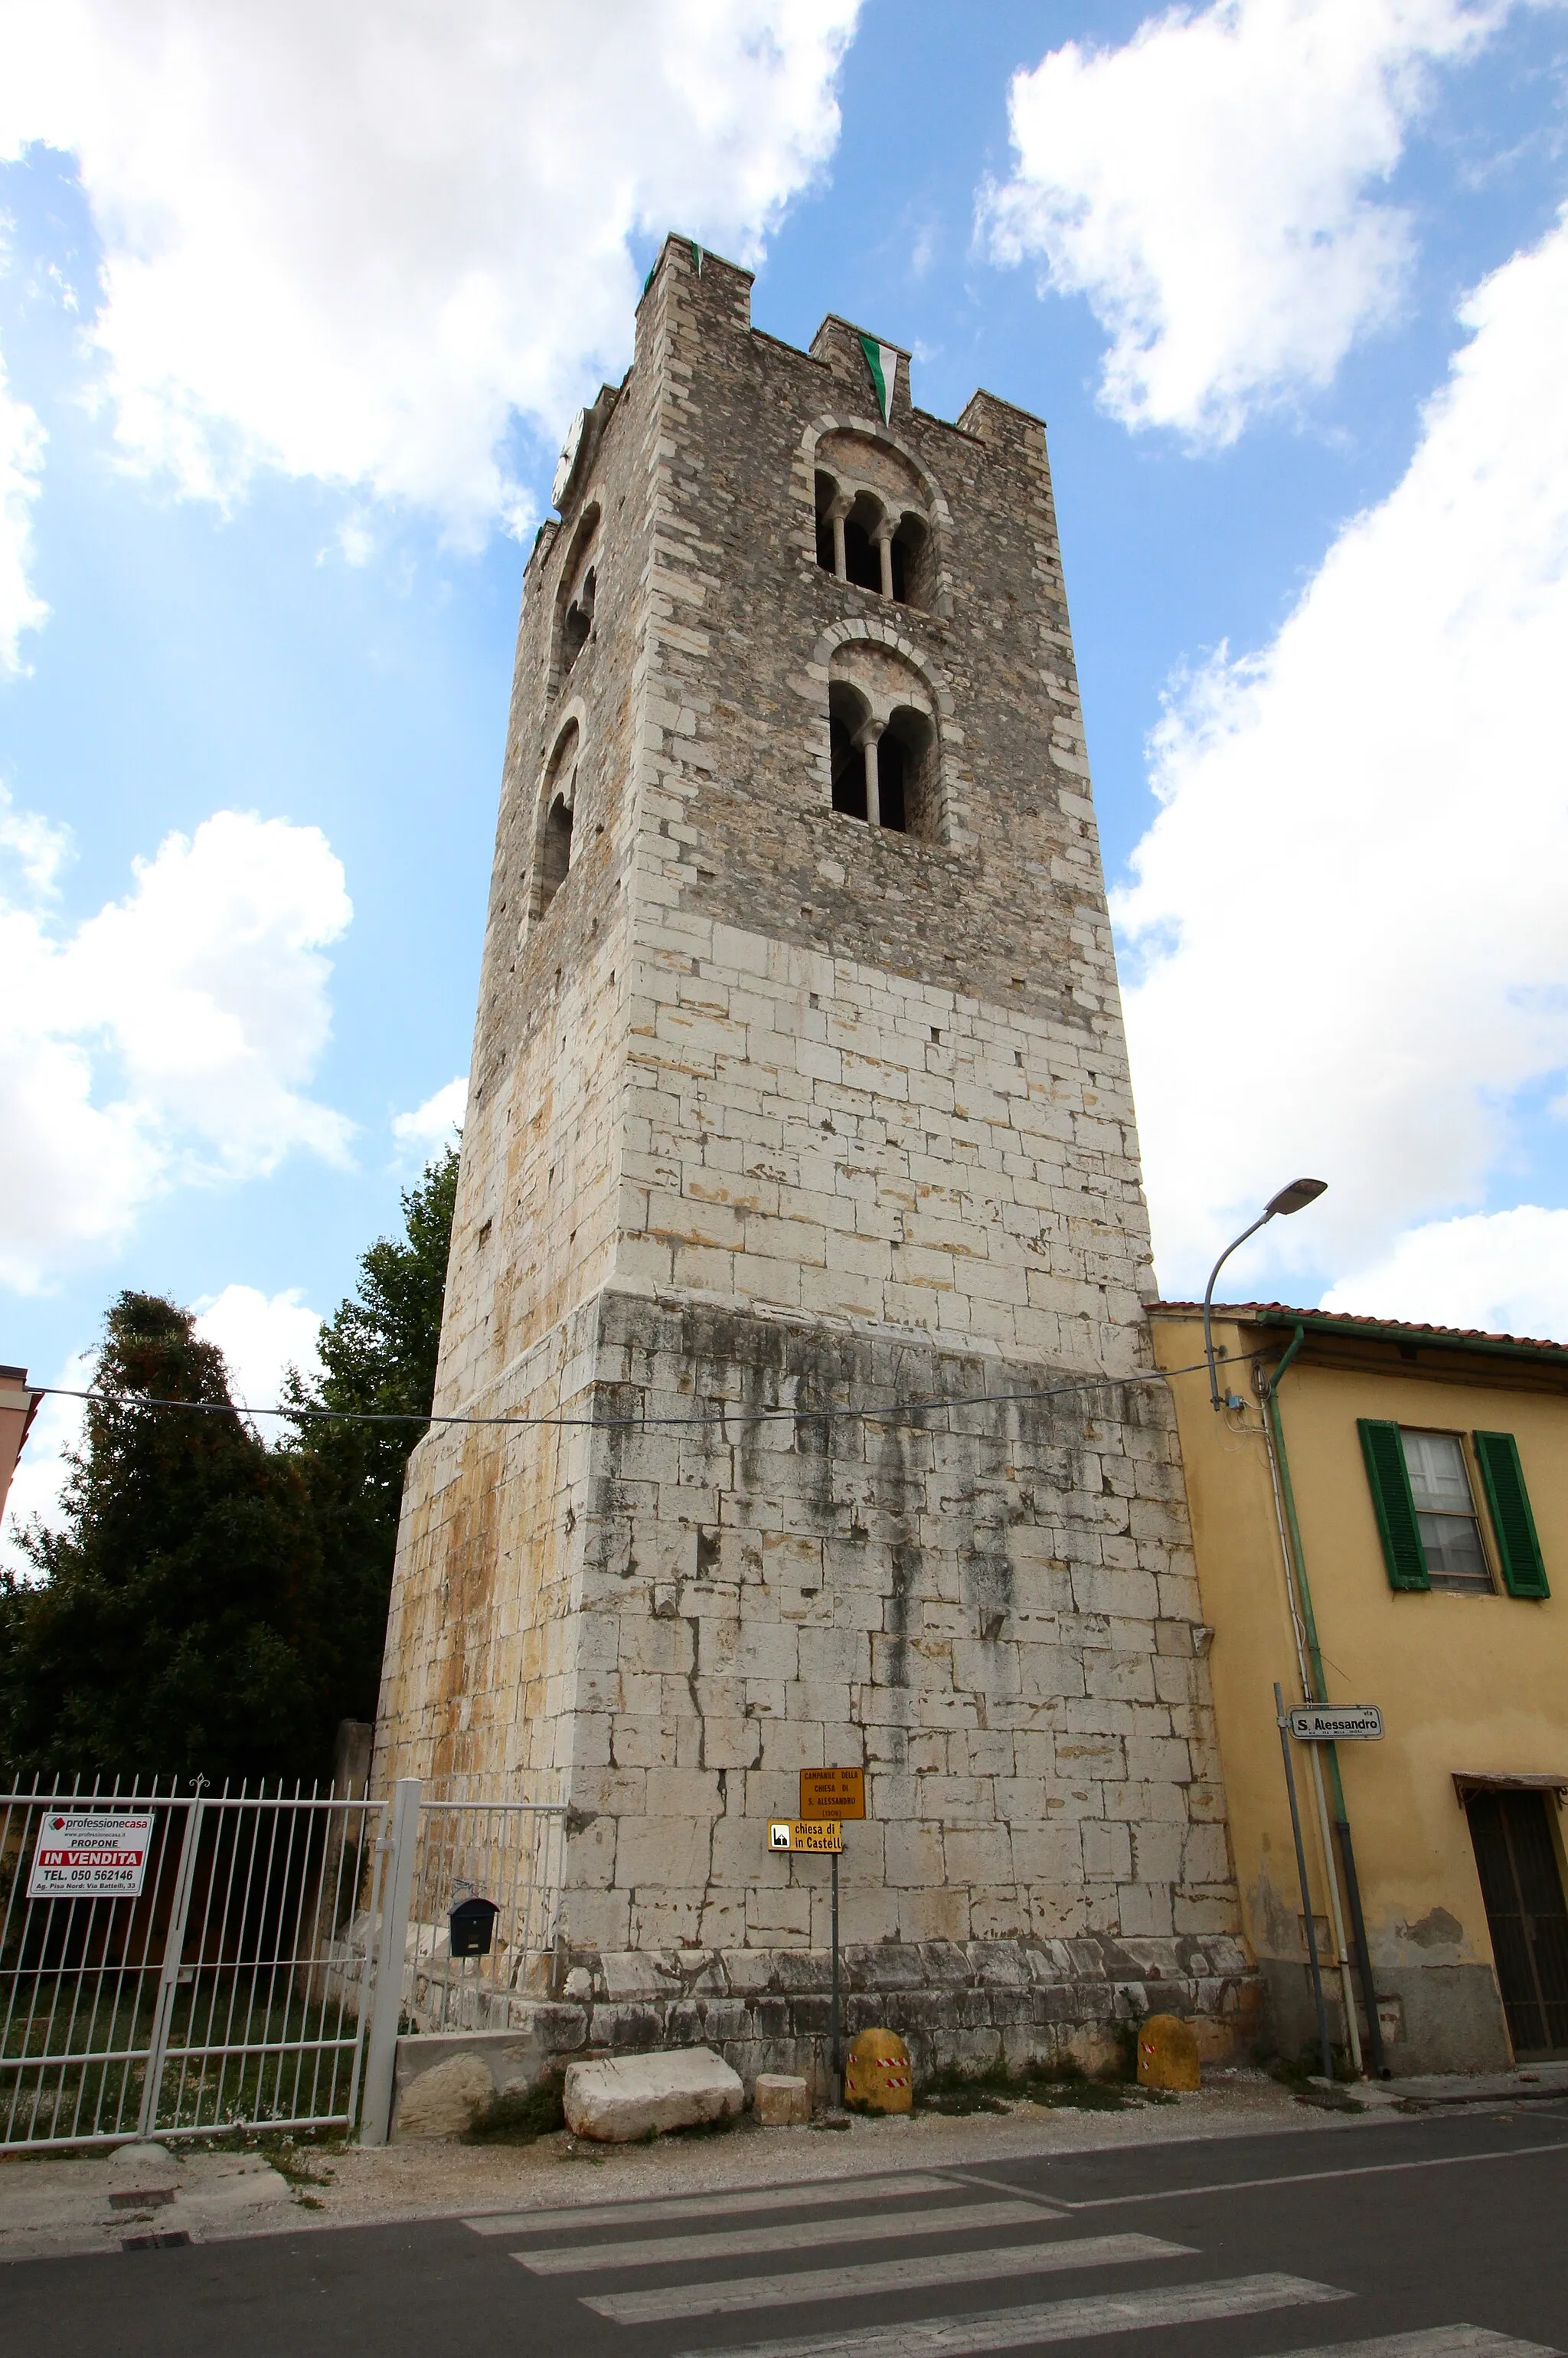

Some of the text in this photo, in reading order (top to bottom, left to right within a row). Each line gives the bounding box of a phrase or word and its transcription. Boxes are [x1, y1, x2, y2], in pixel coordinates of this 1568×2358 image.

[1298, 1718, 1377, 1731] S. Alessandro
[804, 1771, 858, 1780] CAMPANILE DELLA
[817, 1797, 855, 1805] ALESSANDRO
[66, 1817, 148, 1830] professionecasa
[795, 1823, 835, 1834] chiesa di
[795, 1836, 842, 1849] in Castell
[44, 1853, 137, 1864] IN VENDITA
[44, 1870, 132, 1880] TEL. 050 562146
